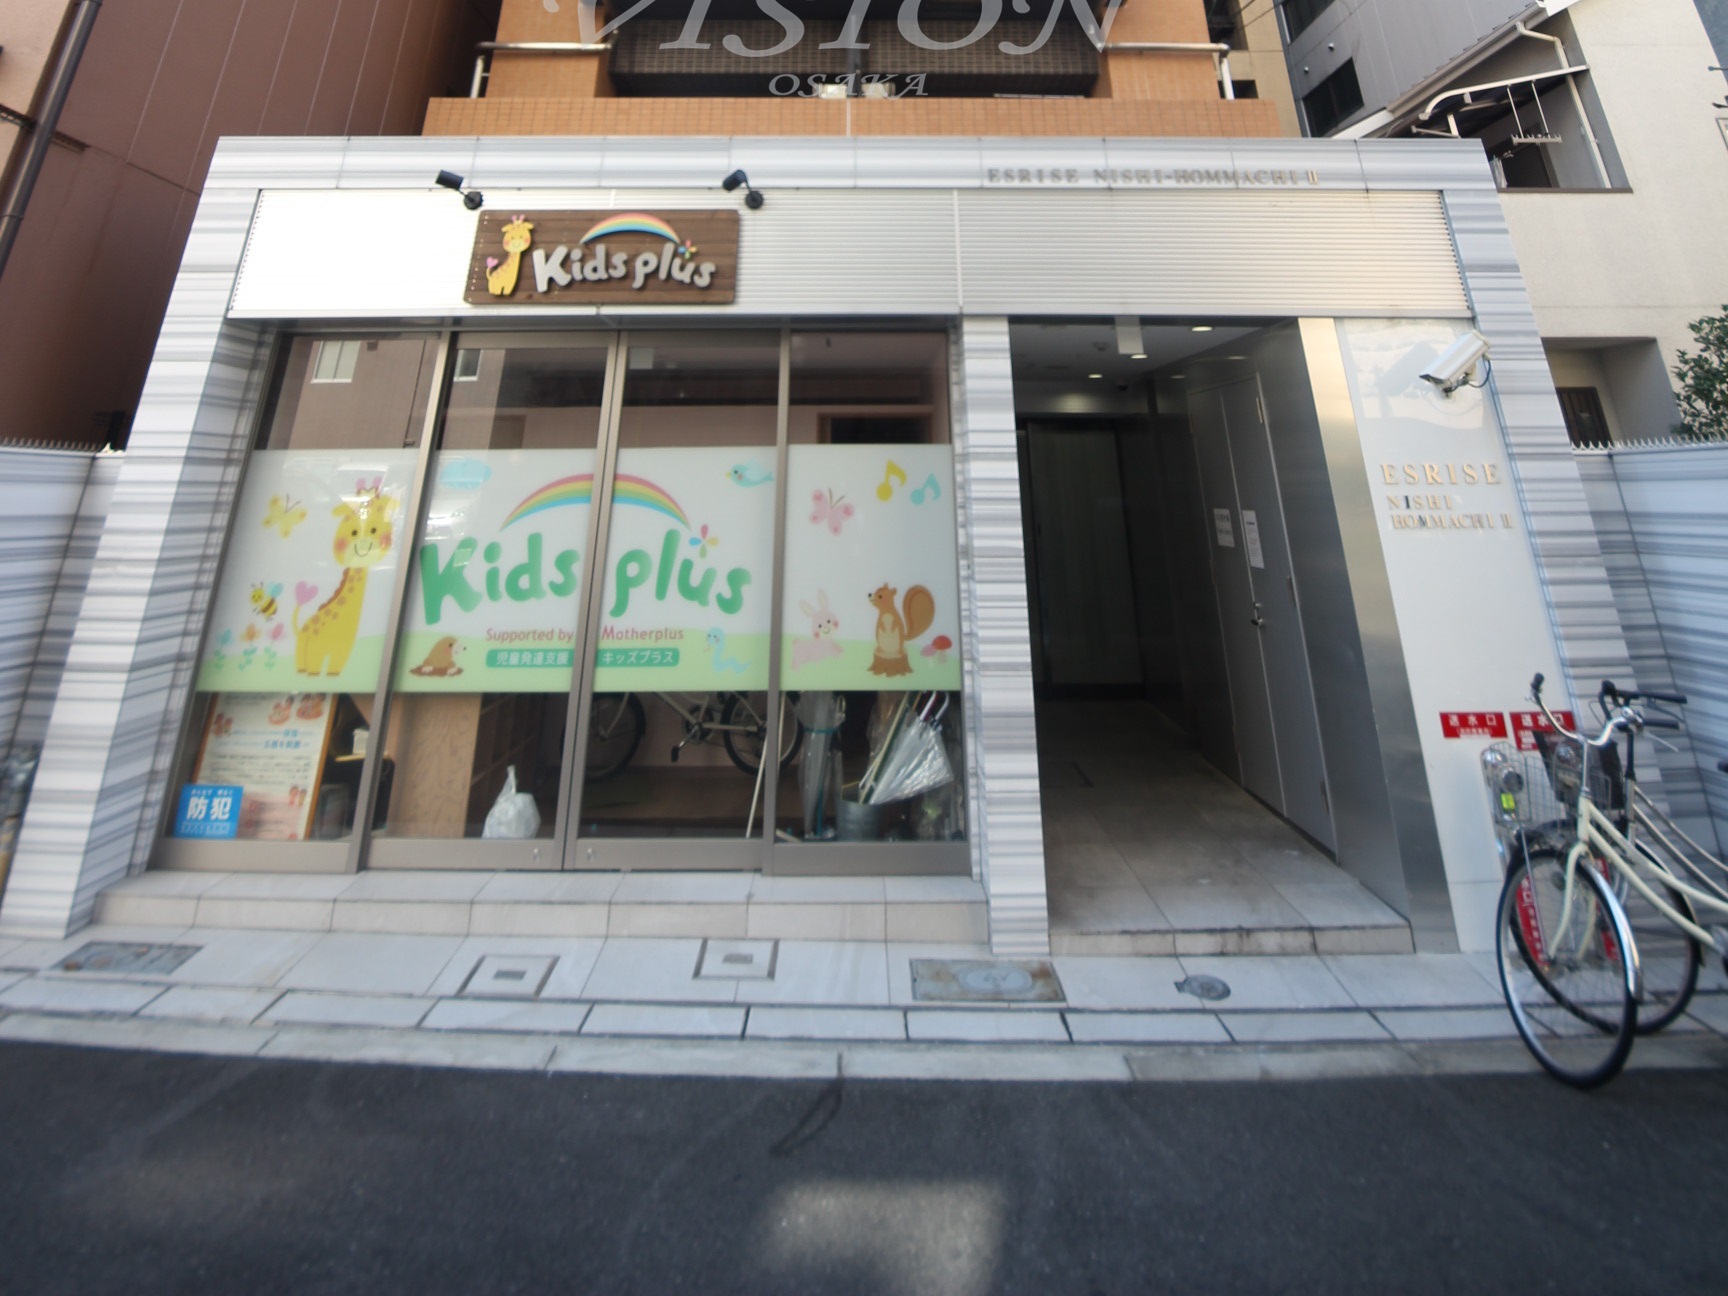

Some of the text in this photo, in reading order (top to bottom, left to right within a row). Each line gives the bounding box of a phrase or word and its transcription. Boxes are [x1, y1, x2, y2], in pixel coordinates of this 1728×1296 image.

[988, 168, 1078, 183] ESRISE
[1093, 168, 1299, 184] NISHI-HOMMACHI
[532, 242, 716, 293] Kids plus
[1380, 463, 1502, 485] ESRISE
[1387, 494, 1453, 510] NISHI
[1391, 512, 1494, 529] HOMMACHI
[419, 529, 752, 626] Kids plus
[486, 625, 684, 643] Supported by Motherplus
[496, 650, 674, 666] 児童発達支援 キッズプラス
[186, 796, 232, 821] 防犯
